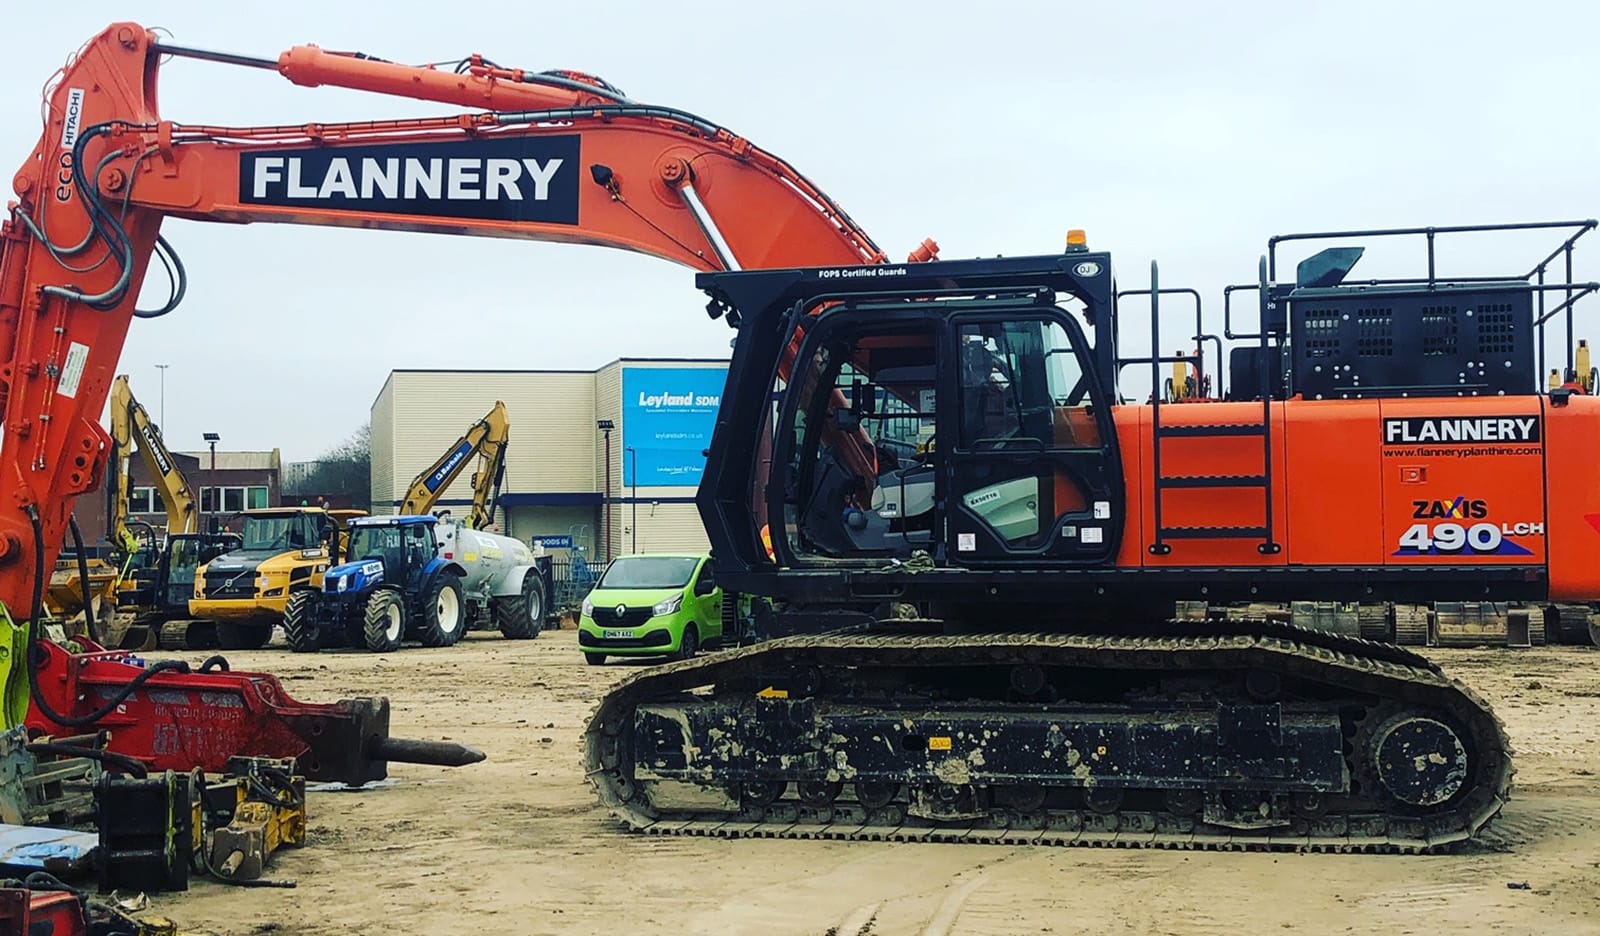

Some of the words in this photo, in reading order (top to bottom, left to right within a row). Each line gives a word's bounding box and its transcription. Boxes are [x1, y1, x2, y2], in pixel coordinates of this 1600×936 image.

[65, 92, 80, 145] HITACHI
[56, 152, 73, 202] eco
[253, 157, 564, 200] FLANNERY
[818, 270, 840, 278] FOPS
[842, 269, 876, 277] Certified
[878, 268, 907, 276] Guards
[639, 392, 693, 408] Leyland
[695, 396, 719, 406] SDM
[1386, 418, 1535, 442] FLANNERY
[143, 428, 169, 471] FLANNERY
[1384, 447, 1542, 458] www.flanneryplanthire.com
[1413, 496, 1487, 519] ZAXIS
[1399, 523, 1501, 552] 490
[1502, 523, 1544, 535] LCH
